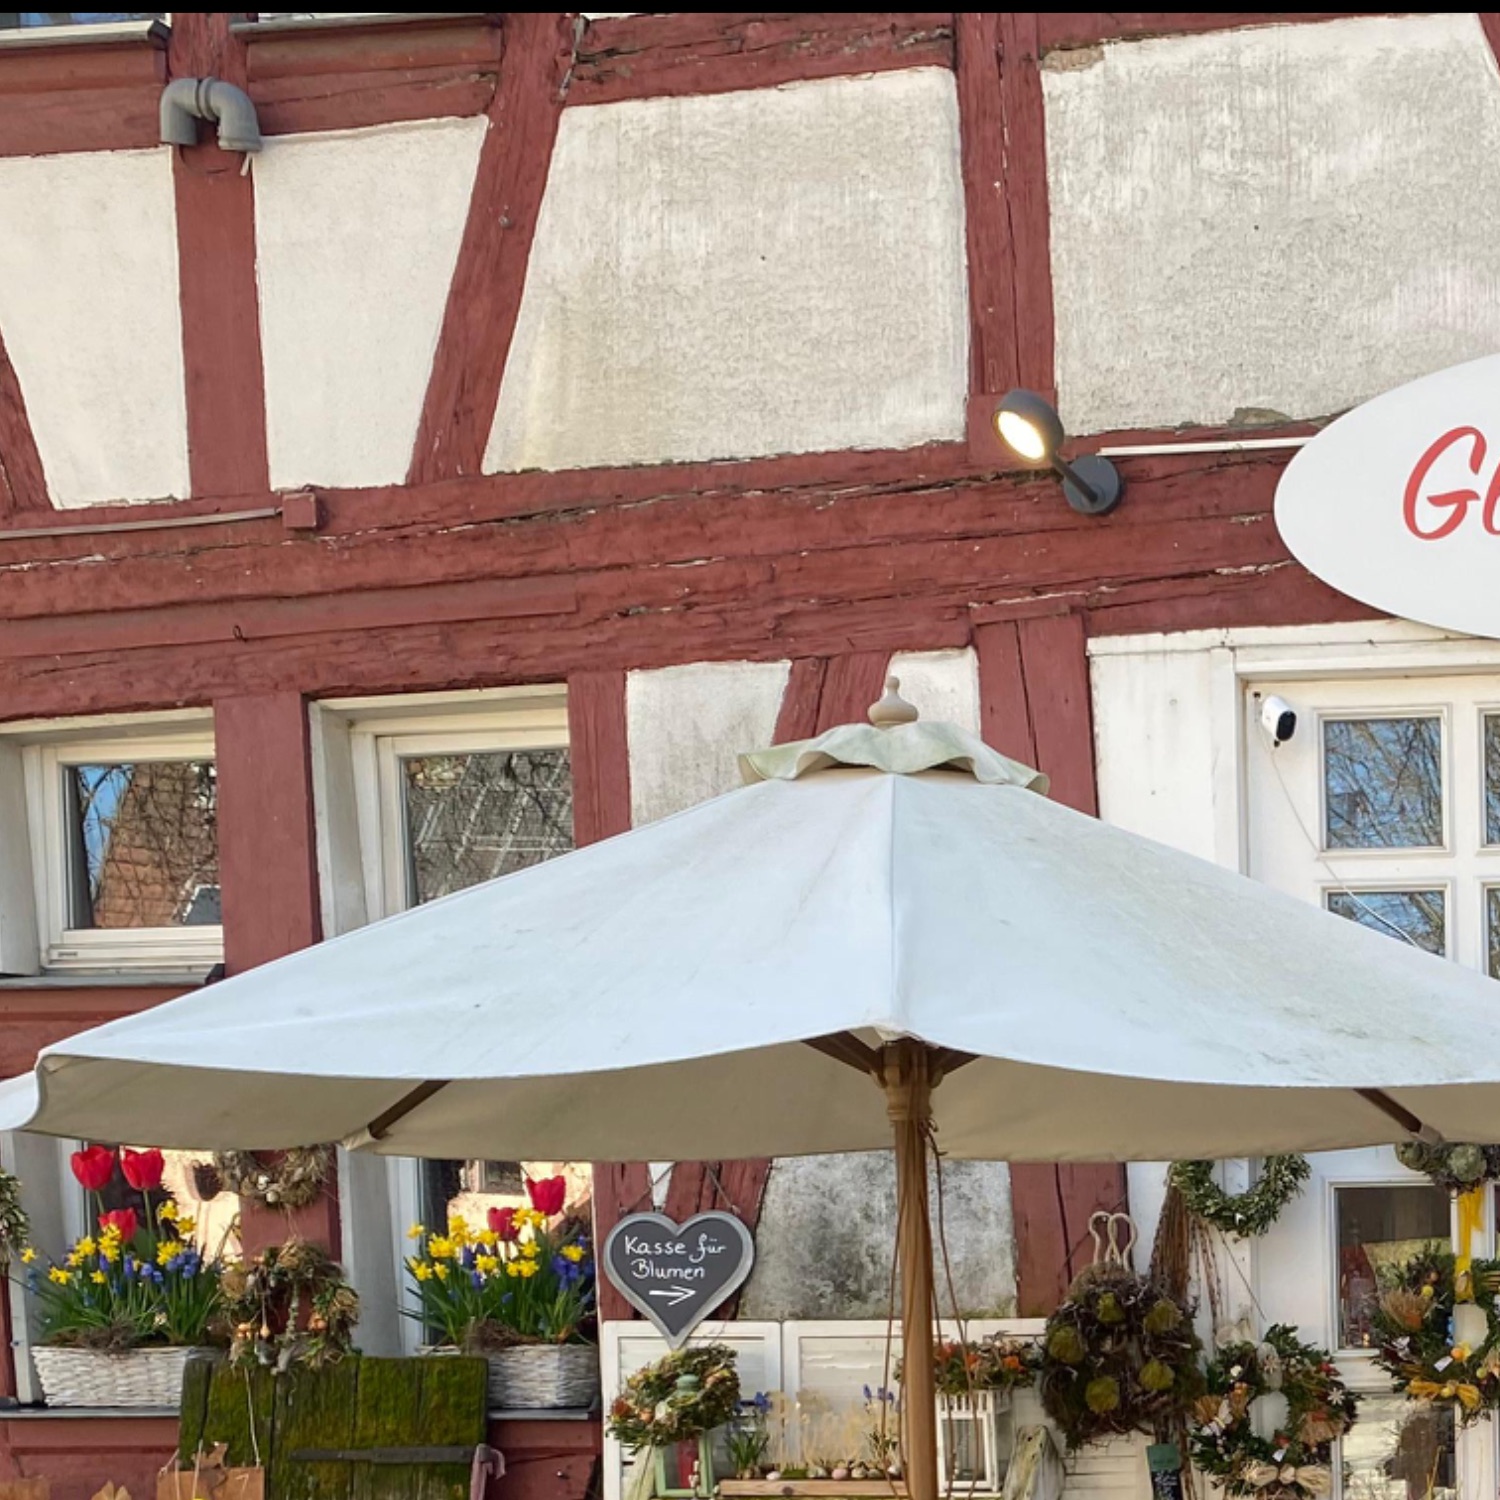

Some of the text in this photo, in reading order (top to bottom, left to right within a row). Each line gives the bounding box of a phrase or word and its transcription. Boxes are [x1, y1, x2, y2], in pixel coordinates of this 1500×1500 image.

[624, 1232, 727, 1263] Kasse für
[629, 1258, 706, 1280] Blumen
